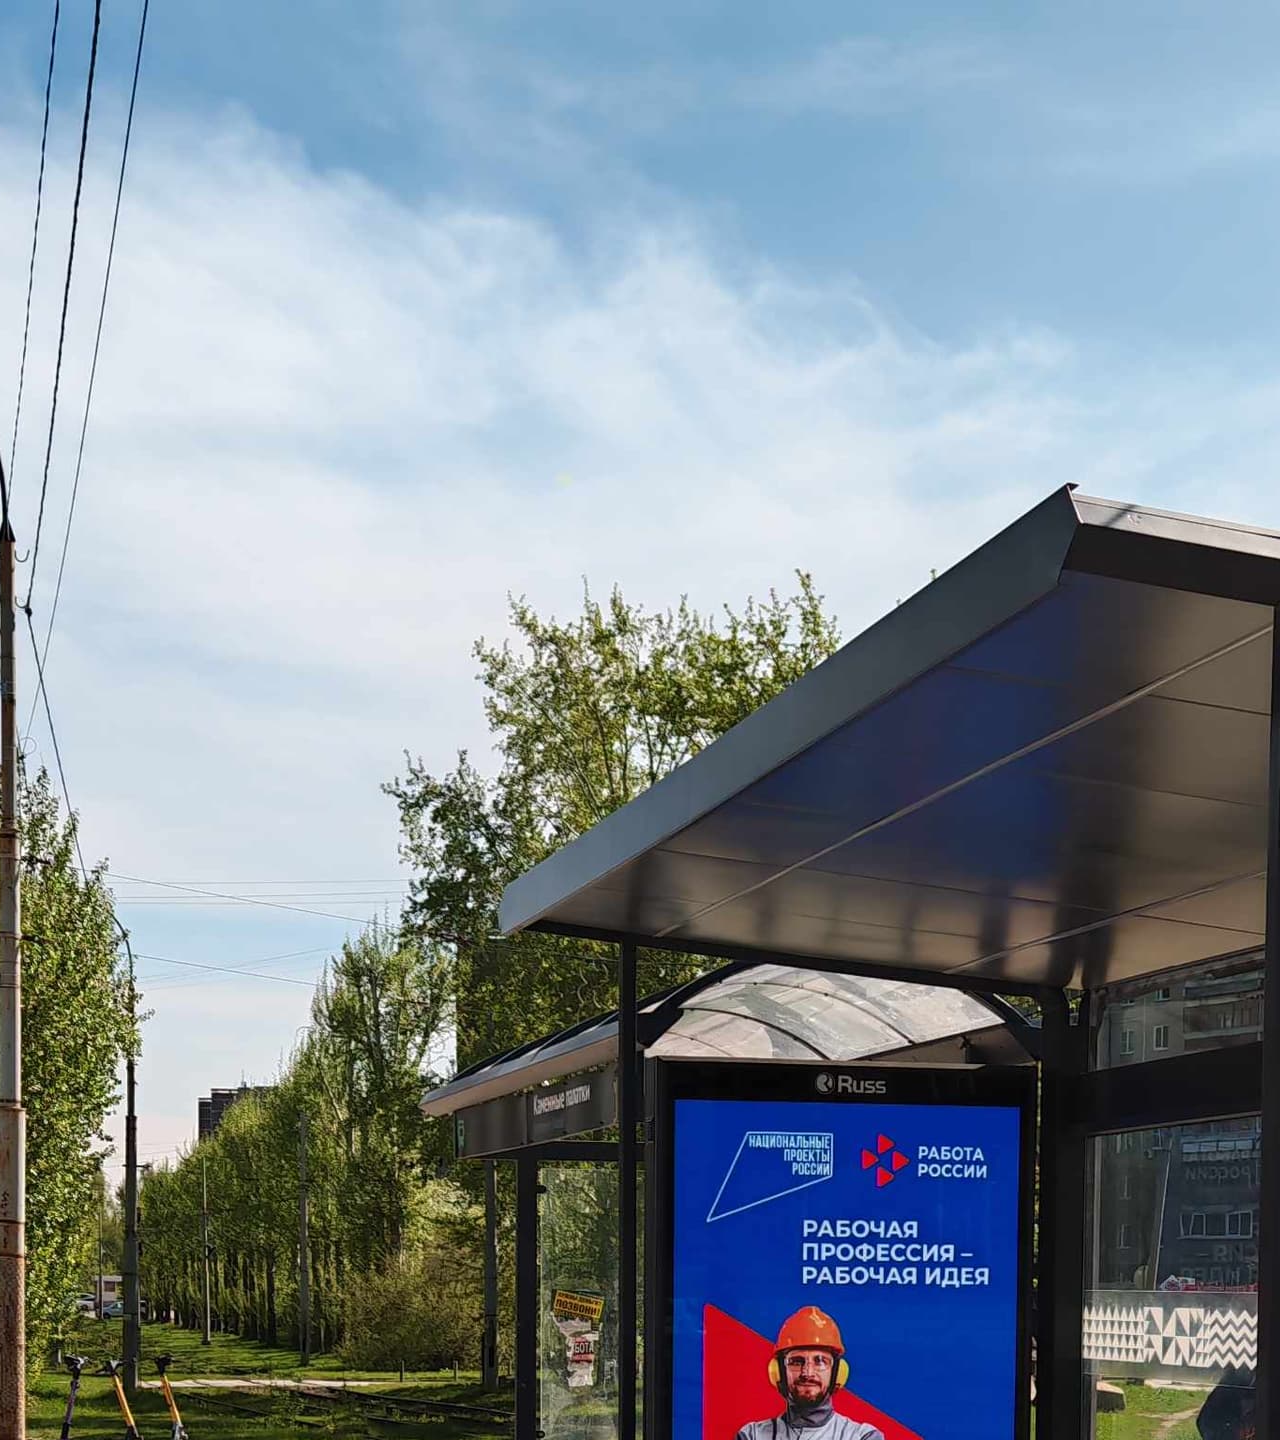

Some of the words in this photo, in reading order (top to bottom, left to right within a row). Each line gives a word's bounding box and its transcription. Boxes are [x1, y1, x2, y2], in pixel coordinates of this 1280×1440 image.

[837, 1075, 886, 1094] Russ
[749, 1135, 830, 1149] НАЦИОНАЛЬНЫЕ
[784, 1149, 830, 1162] ПРОЕКТЫ
[918, 1146, 985, 1161] РАБОТА
[792, 1163, 830, 1176] РОССИИ
[918, 1164, 988, 1178] РОССИИ
[803, 1220, 919, 1238] РАБОЧАЯ
[802, 1243, 955, 1262] ПРОФЕССИЯ
[802, 1266, 917, 1285] РАБОЧАЯ
[925, 1268, 989, 1288] ИДЕЯ
